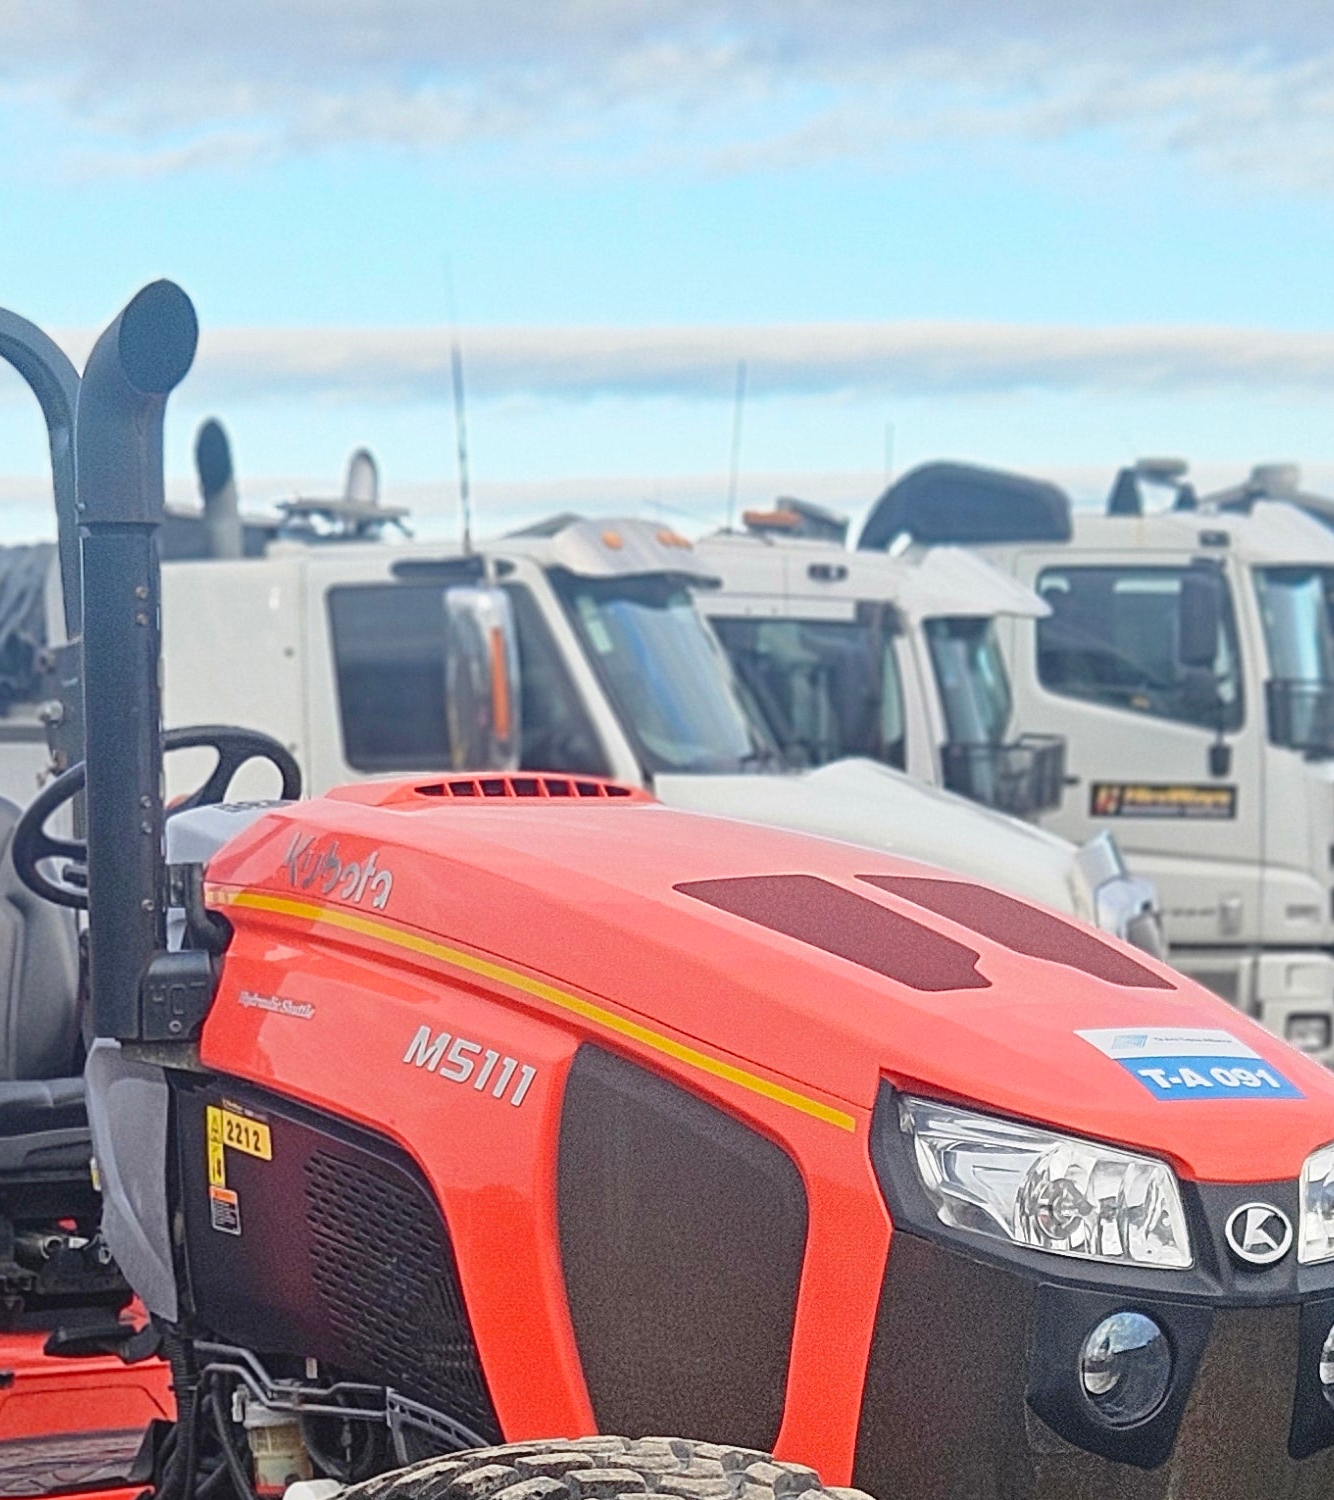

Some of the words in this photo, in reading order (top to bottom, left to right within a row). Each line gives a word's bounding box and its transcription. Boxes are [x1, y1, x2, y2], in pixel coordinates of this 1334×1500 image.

[283, 831, 393, 910] Kubota
[402, 1025, 538, 1107] M5111
[1137, 1067, 1214, 1090] T-A
[1209, 1067, 1281, 1090] 091
[226, 1119, 261, 1152] 2212
